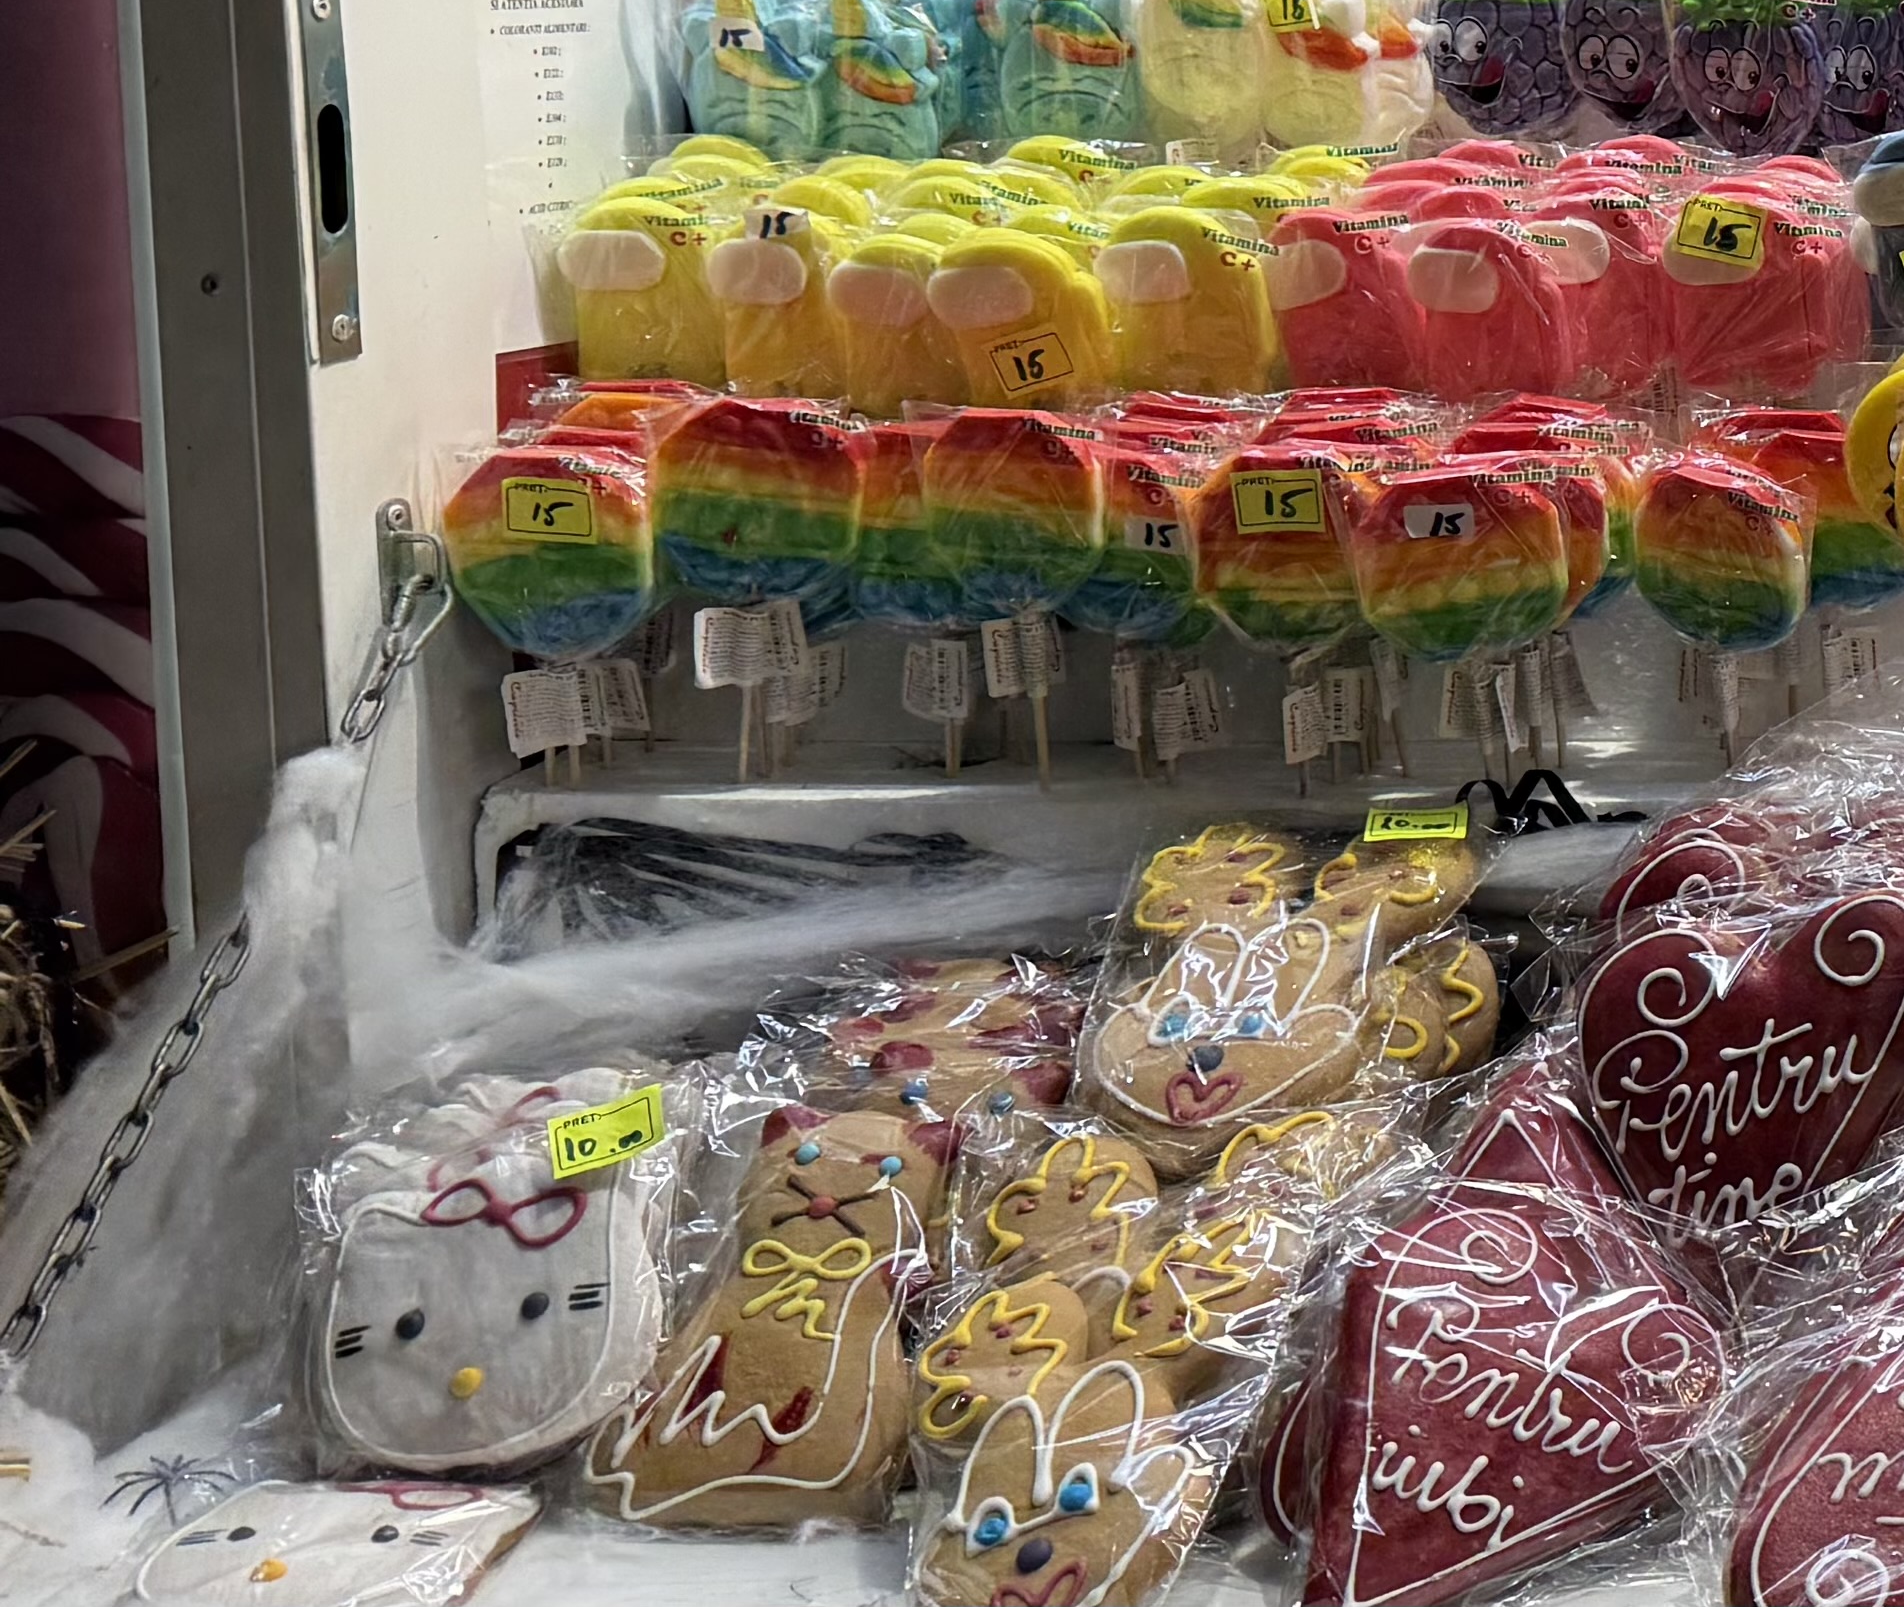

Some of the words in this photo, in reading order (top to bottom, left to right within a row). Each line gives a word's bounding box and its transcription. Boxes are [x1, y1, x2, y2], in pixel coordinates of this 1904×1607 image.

[1253, 196, 1330, 209] Vitamina
[760, 212, 791, 239] 15
[1334, 214, 1409, 233] Vitamina
[1773, 222, 1842, 238] Vitamina
[1202, 227, 1280, 255] Vitamina
[1013, 350, 1045, 381] 15
[532, 502, 574, 526] 15
[1265, 488, 1313, 517] 15
[1144, 523, 1178, 547] 15
[1429, 512, 1464, 535] 15
[1592, 1018, 1876, 1162] Pentru
[1386, 1282, 1633, 1474] Pentru
